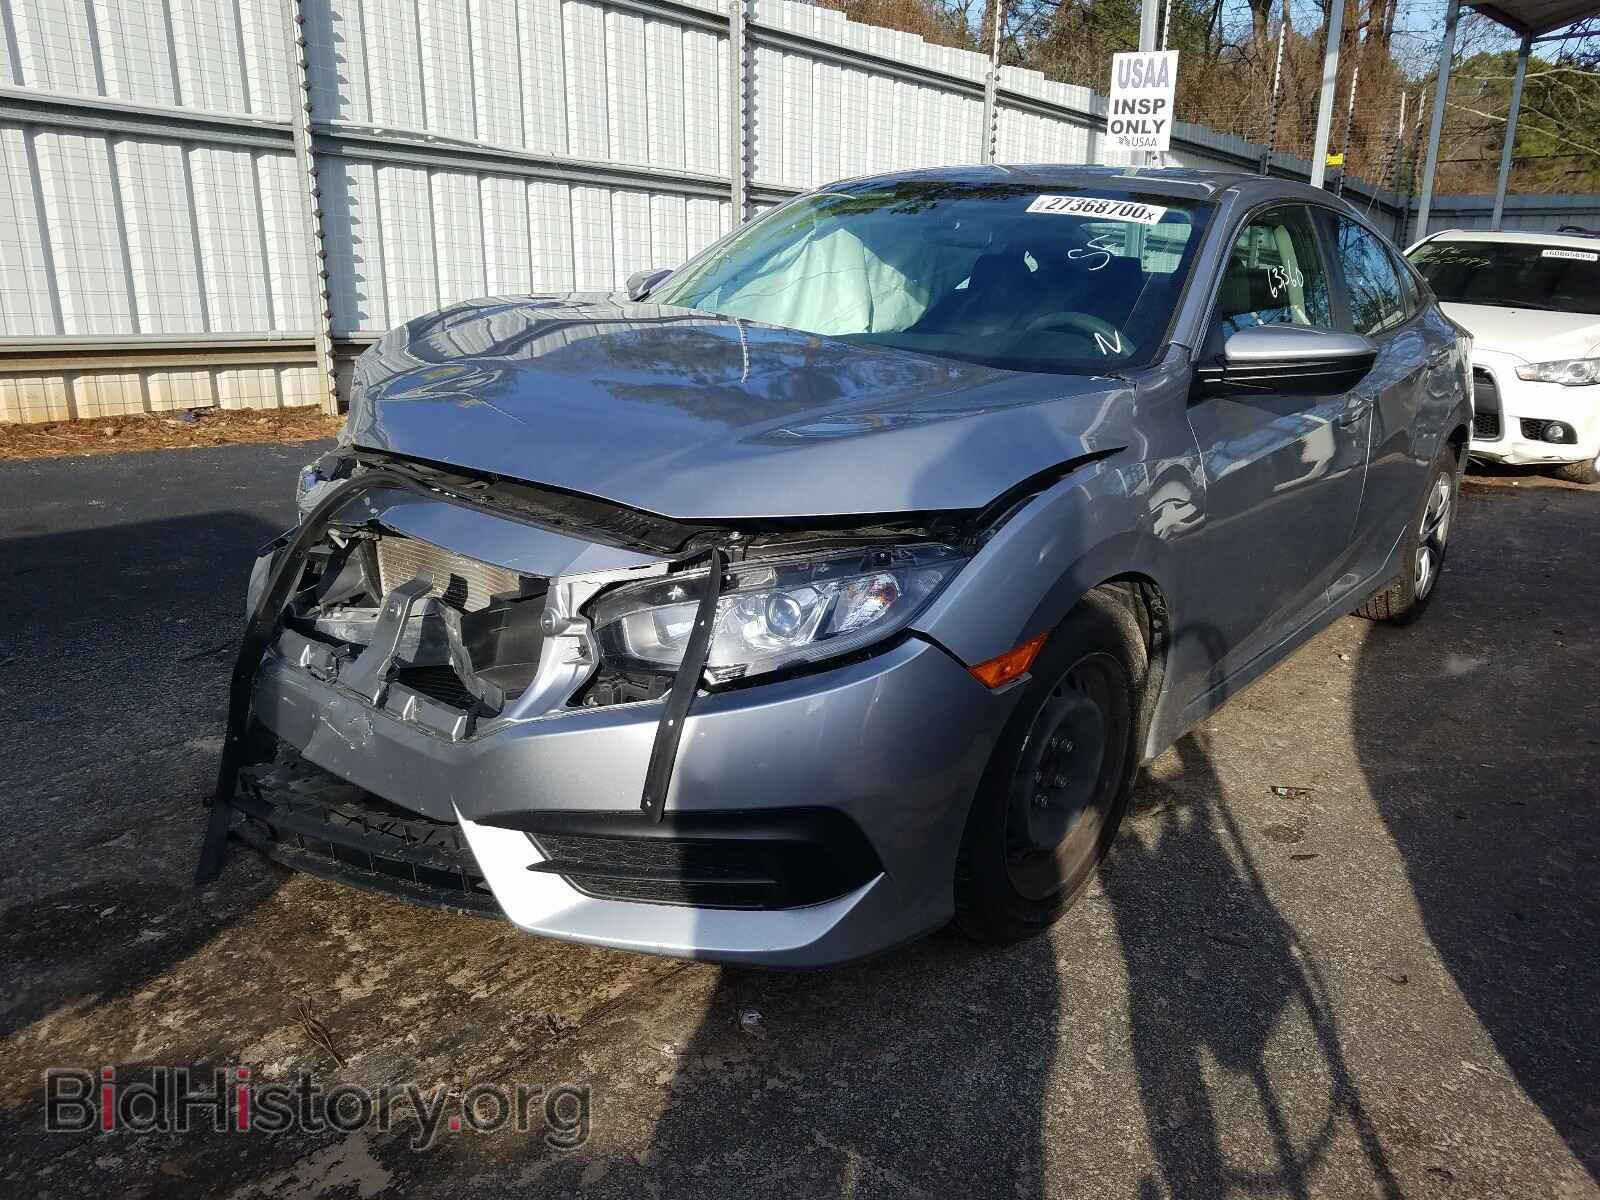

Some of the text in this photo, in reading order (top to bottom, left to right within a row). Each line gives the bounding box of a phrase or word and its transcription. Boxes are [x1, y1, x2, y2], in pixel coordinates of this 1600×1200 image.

[1118, 56, 1169, 88] USAA
[1114, 98, 1166, 115] INSP
[1110, 119, 1166, 134] ONLY
[1131, 136, 1158, 147] USAA
[1094, 328, 1121, 355] N
